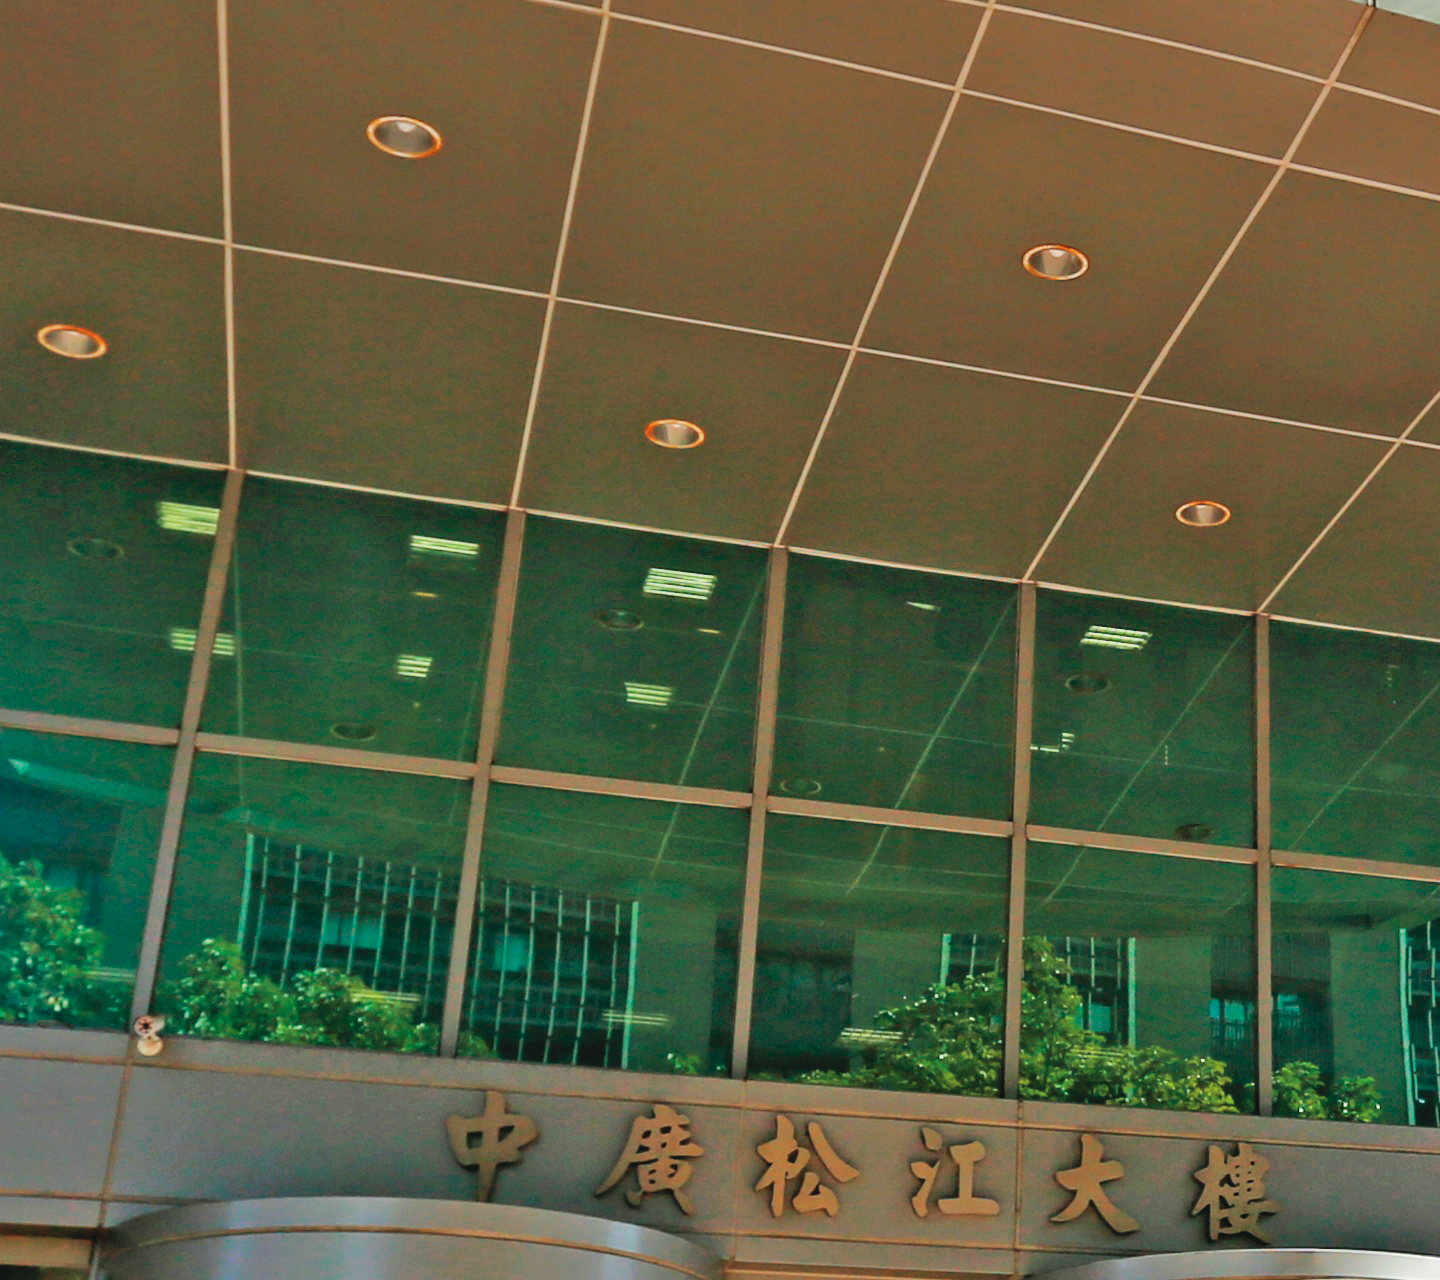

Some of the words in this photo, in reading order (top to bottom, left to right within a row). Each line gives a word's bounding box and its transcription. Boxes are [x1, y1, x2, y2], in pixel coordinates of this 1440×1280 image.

[444, 1090, 1281, 1245] 中廣松江大樓
